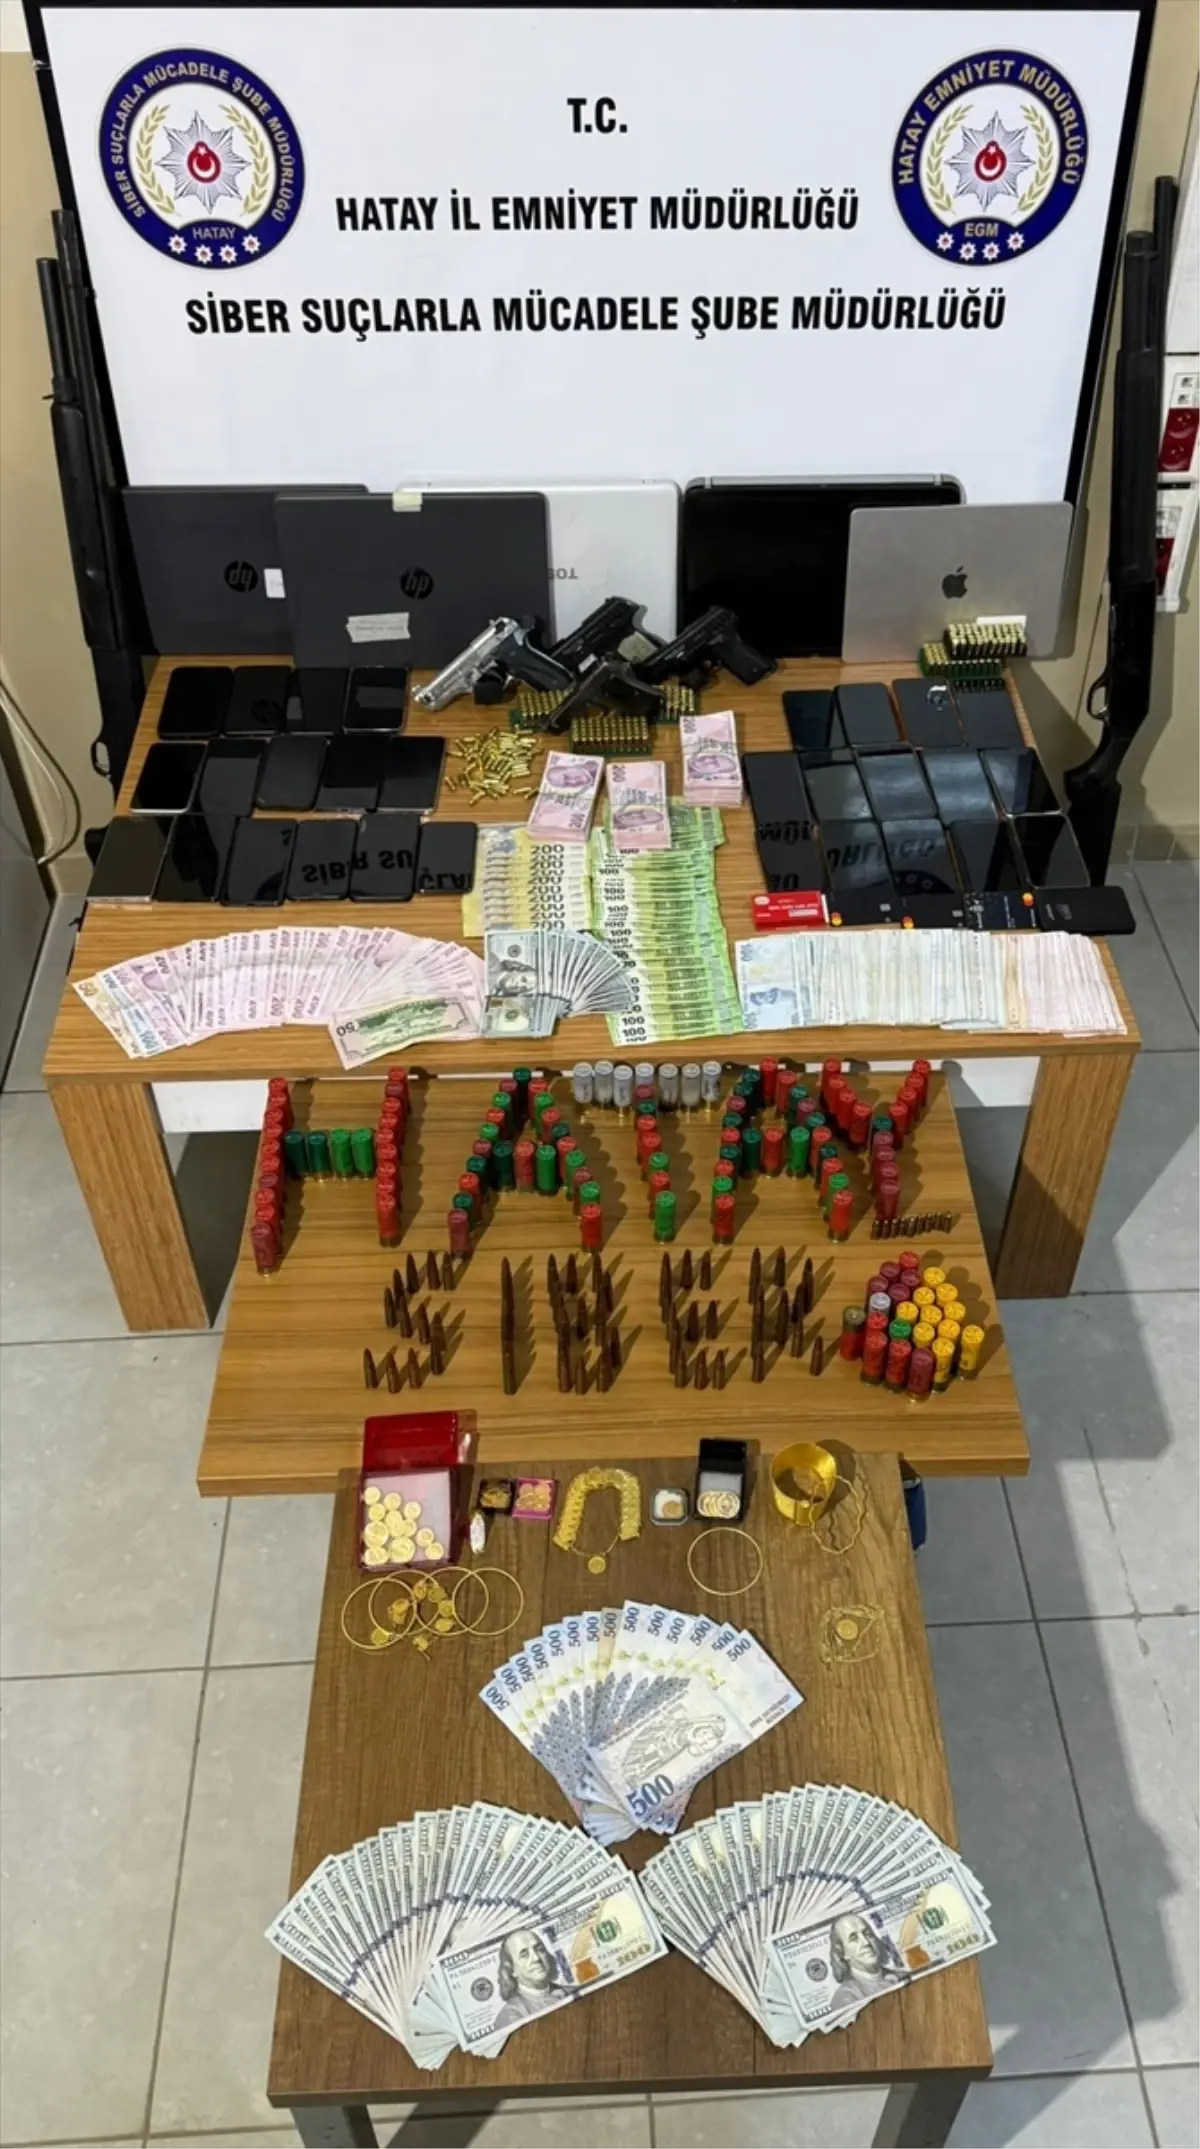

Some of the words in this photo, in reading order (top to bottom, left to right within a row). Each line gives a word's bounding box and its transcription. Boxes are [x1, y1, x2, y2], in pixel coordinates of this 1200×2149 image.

[142, 61, 229, 89] MÜCADELE
[231, 76, 273, 117] ŞUBE
[111, 84, 146, 165] SUÇLARLA
[566, 97, 628, 134] T.C.
[898, 111, 927, 185] HATAY
[923, 60, 1016, 113] EMNİYET
[1019, 64, 1086, 185] MÜDÜRLÜĞÜ
[266, 116, 296, 223] MÜDÜRLÜĞÜ
[115, 170, 147, 219] SİBER
[335, 196, 439, 231] HATAY
[450, 188, 481, 231] İL
[491, 188, 638, 230] EMNİYET
[650, 187, 859, 230] MÜDÜRLÜĞÜ
[191, 227, 237, 240] HATAY
[963, 222, 1000, 238] EGM
[185, 291, 290, 334] SİBER
[301, 297, 482, 343] SUÇLARLA
[493, 288, 679, 331] MÜCADELE
[690, 295, 780, 341] ŞUBE
[790, 287, 1007, 330] MÜDÜRLÜĞÜ
[402, 567, 432, 599] hp
[335, 1020, 356, 1037] 50
[621, 1016, 646, 1026] 100
[621, 1027, 646, 1037] 100
[587, 1616, 600, 1643] 500
[604, 1612, 618, 1639] 500
[623, 1606, 640, 1634] 500
[647, 1610, 667, 1637] 500
[666, 1617, 686, 1645] 500
[689, 1619, 712, 1646] 500
[548, 1630, 564, 1657] 500
[567, 1620, 582, 1648] 500
[711, 1629, 736, 1652] 500
[531, 1643, 549, 1670] 500
[726, 1637, 752, 1662] 500
[500, 1667, 523, 1693] 500
[515, 1656, 536, 1682] 500
[486, 1686, 511, 1711] 500
[625, 1774, 675, 1818] 500
